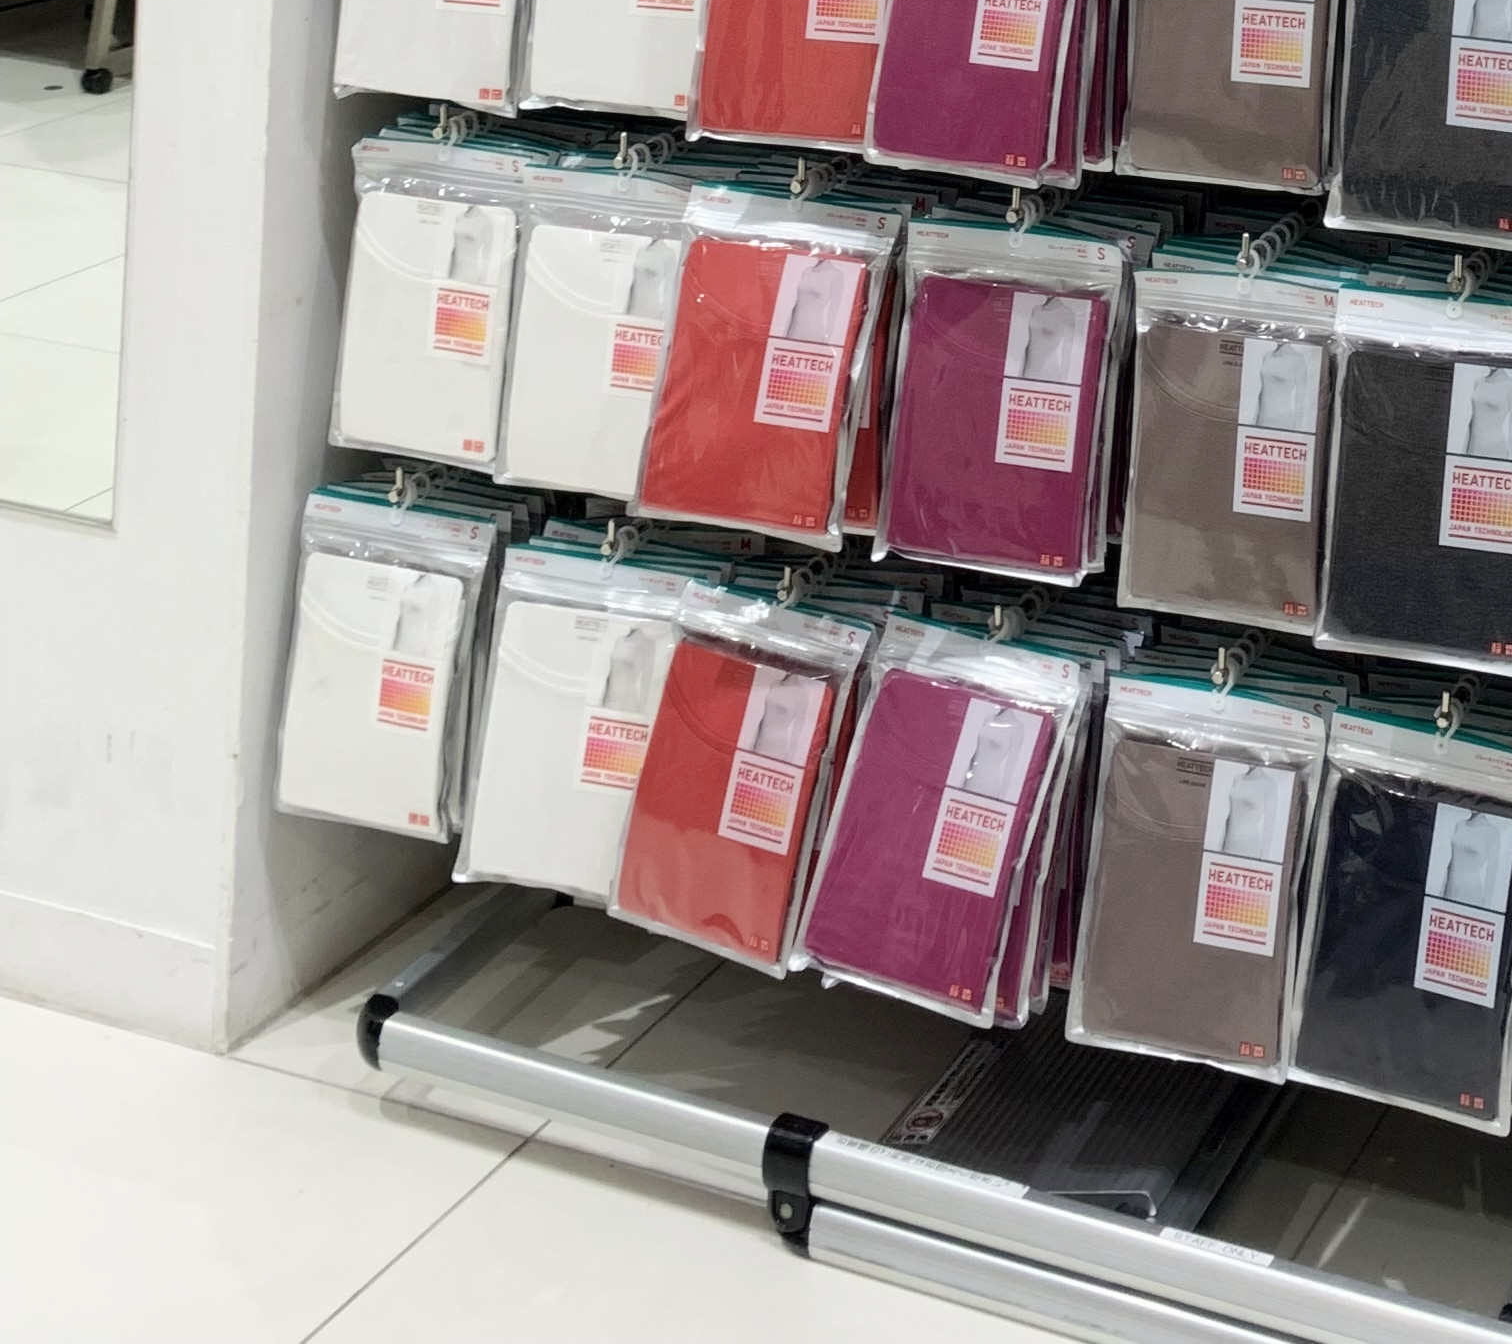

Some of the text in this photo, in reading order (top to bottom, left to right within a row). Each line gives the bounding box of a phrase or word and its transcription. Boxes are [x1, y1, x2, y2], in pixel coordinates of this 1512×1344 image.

[1242, 13, 1305, 30] HEATTECH
[771, 353, 833, 373] HEATTECH
[1009, 393, 1071, 412] HEATTECH
[1244, 441, 1307, 460] HEATTECH
[588, 721, 648, 742] HEATTECH
[945, 804, 1005, 833] HEATTECH
[1208, 869, 1272, 892] HEATTECH
[1429, 915, 1494, 942] HEATTECH
